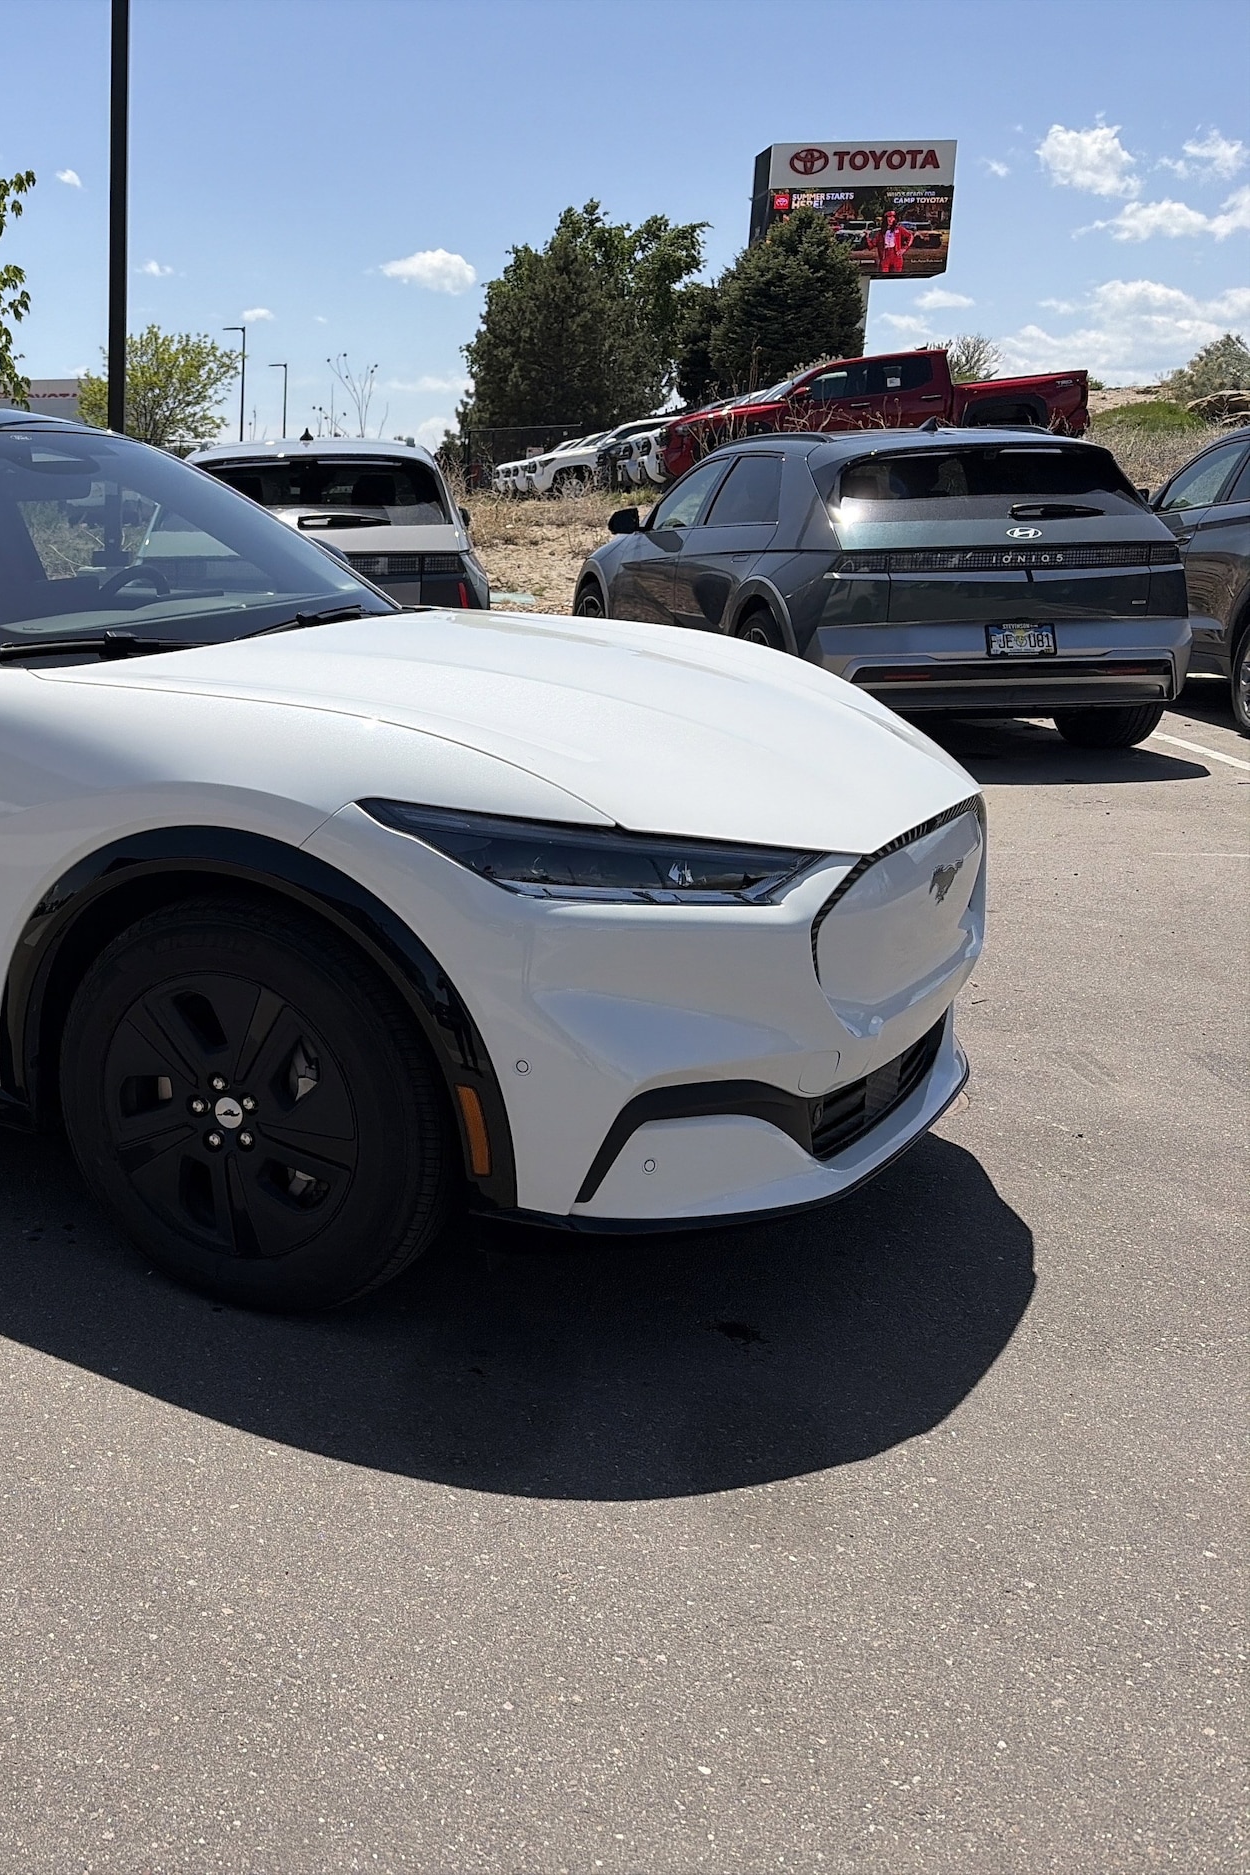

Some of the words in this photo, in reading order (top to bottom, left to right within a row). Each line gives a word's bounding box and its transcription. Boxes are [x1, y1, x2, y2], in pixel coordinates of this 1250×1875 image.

[833, 149, 941, 171] TOYOTA
[791, 193, 825, 201] SUMMER
[826, 192, 854, 200] STARTS
[916, 196, 949, 204] TOYOTA?
[1056, 553, 1063, 562] 5
